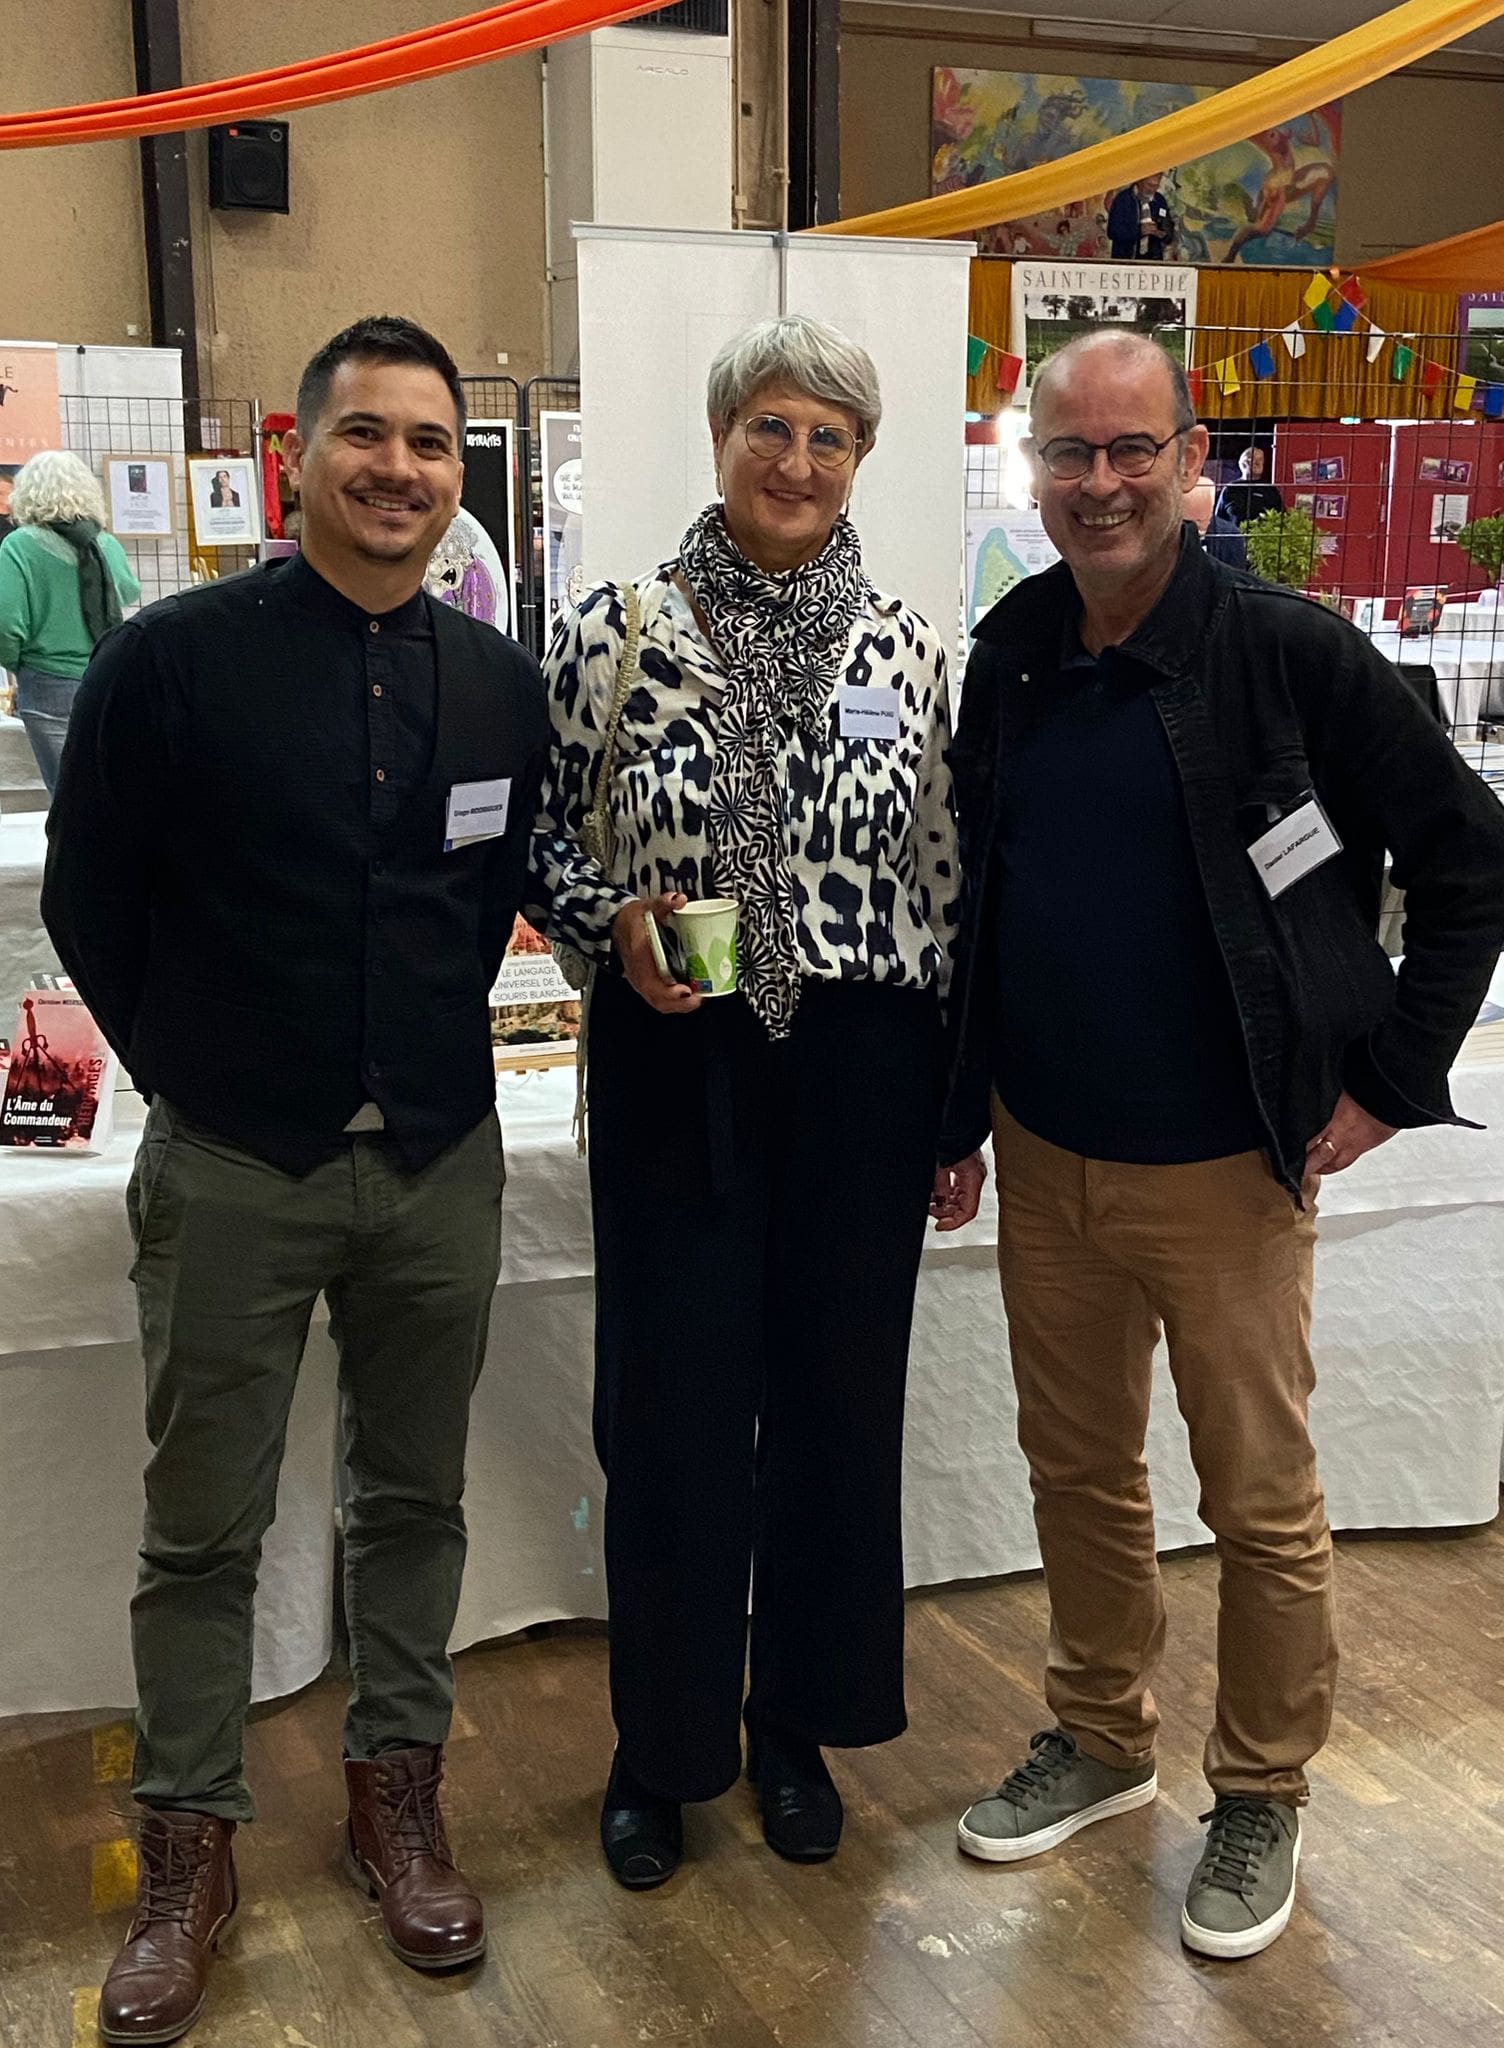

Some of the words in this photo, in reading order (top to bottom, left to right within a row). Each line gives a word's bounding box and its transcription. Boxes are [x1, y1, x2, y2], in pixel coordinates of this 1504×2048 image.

[1023, 269, 1187, 292] SAINT-ESTÈPHE
[514, 966, 557, 977] LANGAGE
[543, 977, 554, 986] DE
[494, 991, 528, 1001] SOURIS
[529, 988, 569, 999] BLANCHE
[6, 1095, 38, 1111] L'Âme
[3, 1112, 73, 1127] Commandeur
